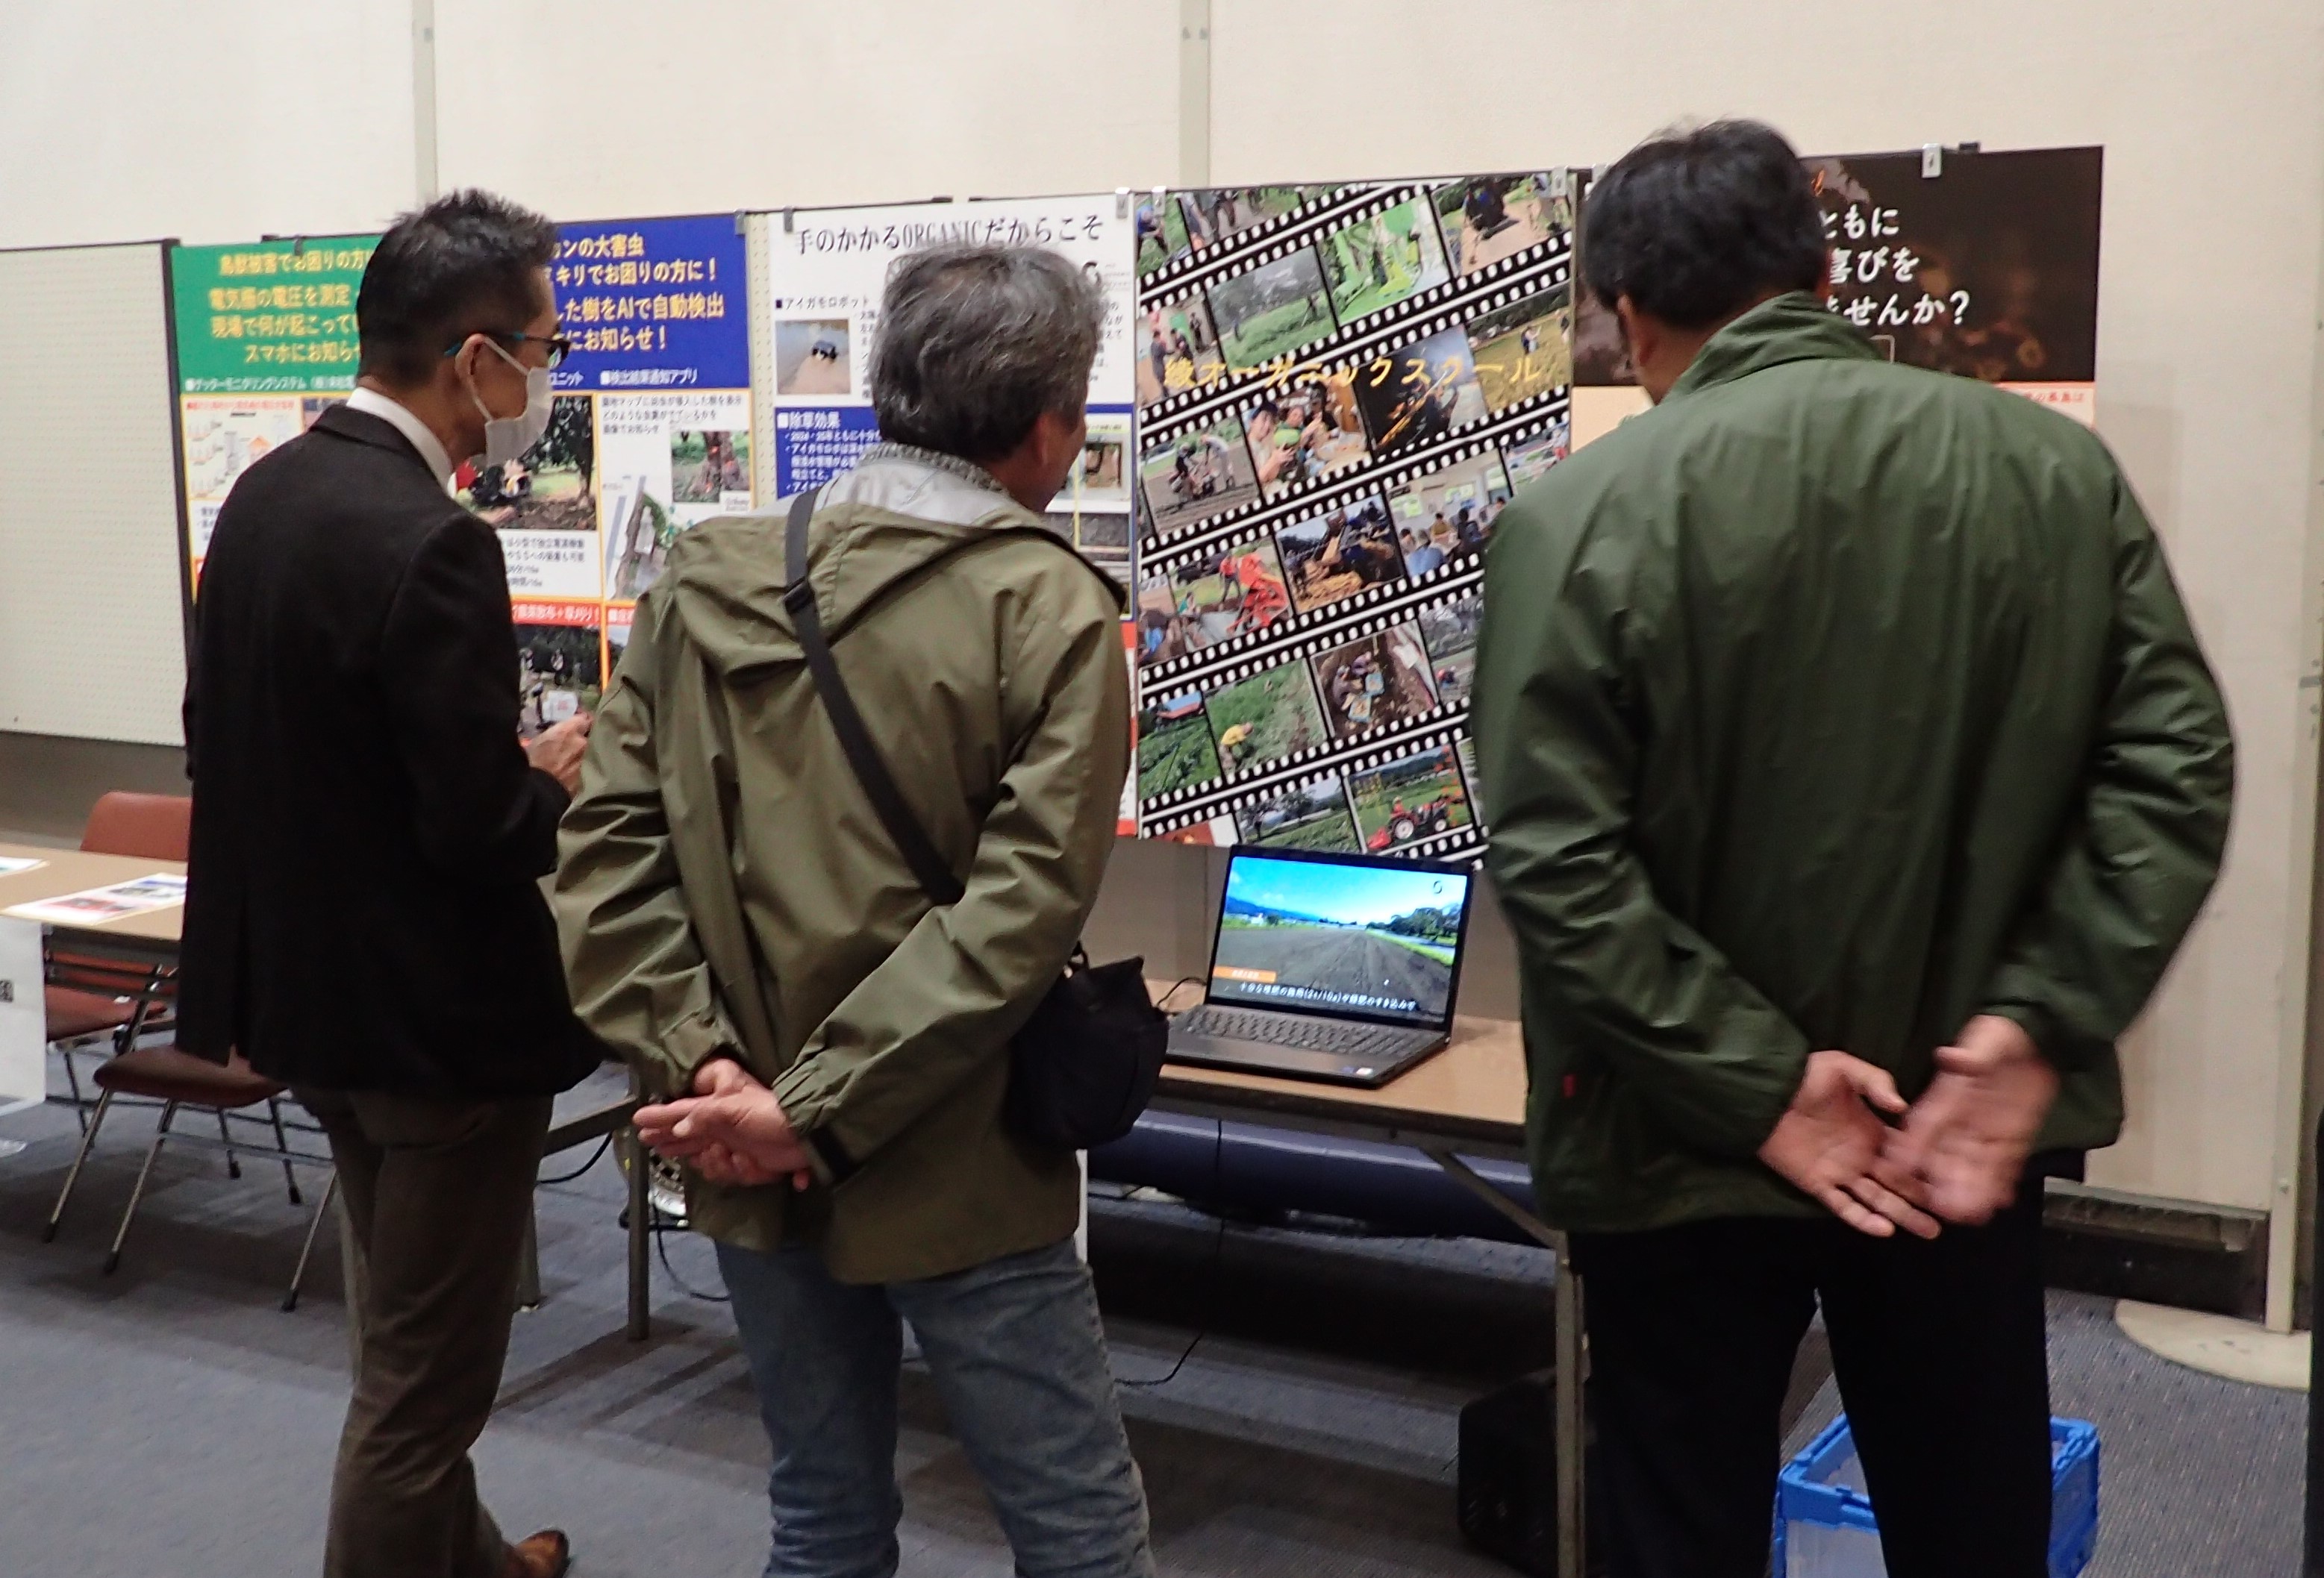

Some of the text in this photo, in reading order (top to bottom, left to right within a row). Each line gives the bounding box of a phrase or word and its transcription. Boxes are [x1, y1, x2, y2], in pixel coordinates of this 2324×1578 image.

[557, 292, 725, 322] た樹をAIで自動検出
[552, 325, 666, 351] にお知らせ！
[246, 342, 360, 363] スマホにお知ら
